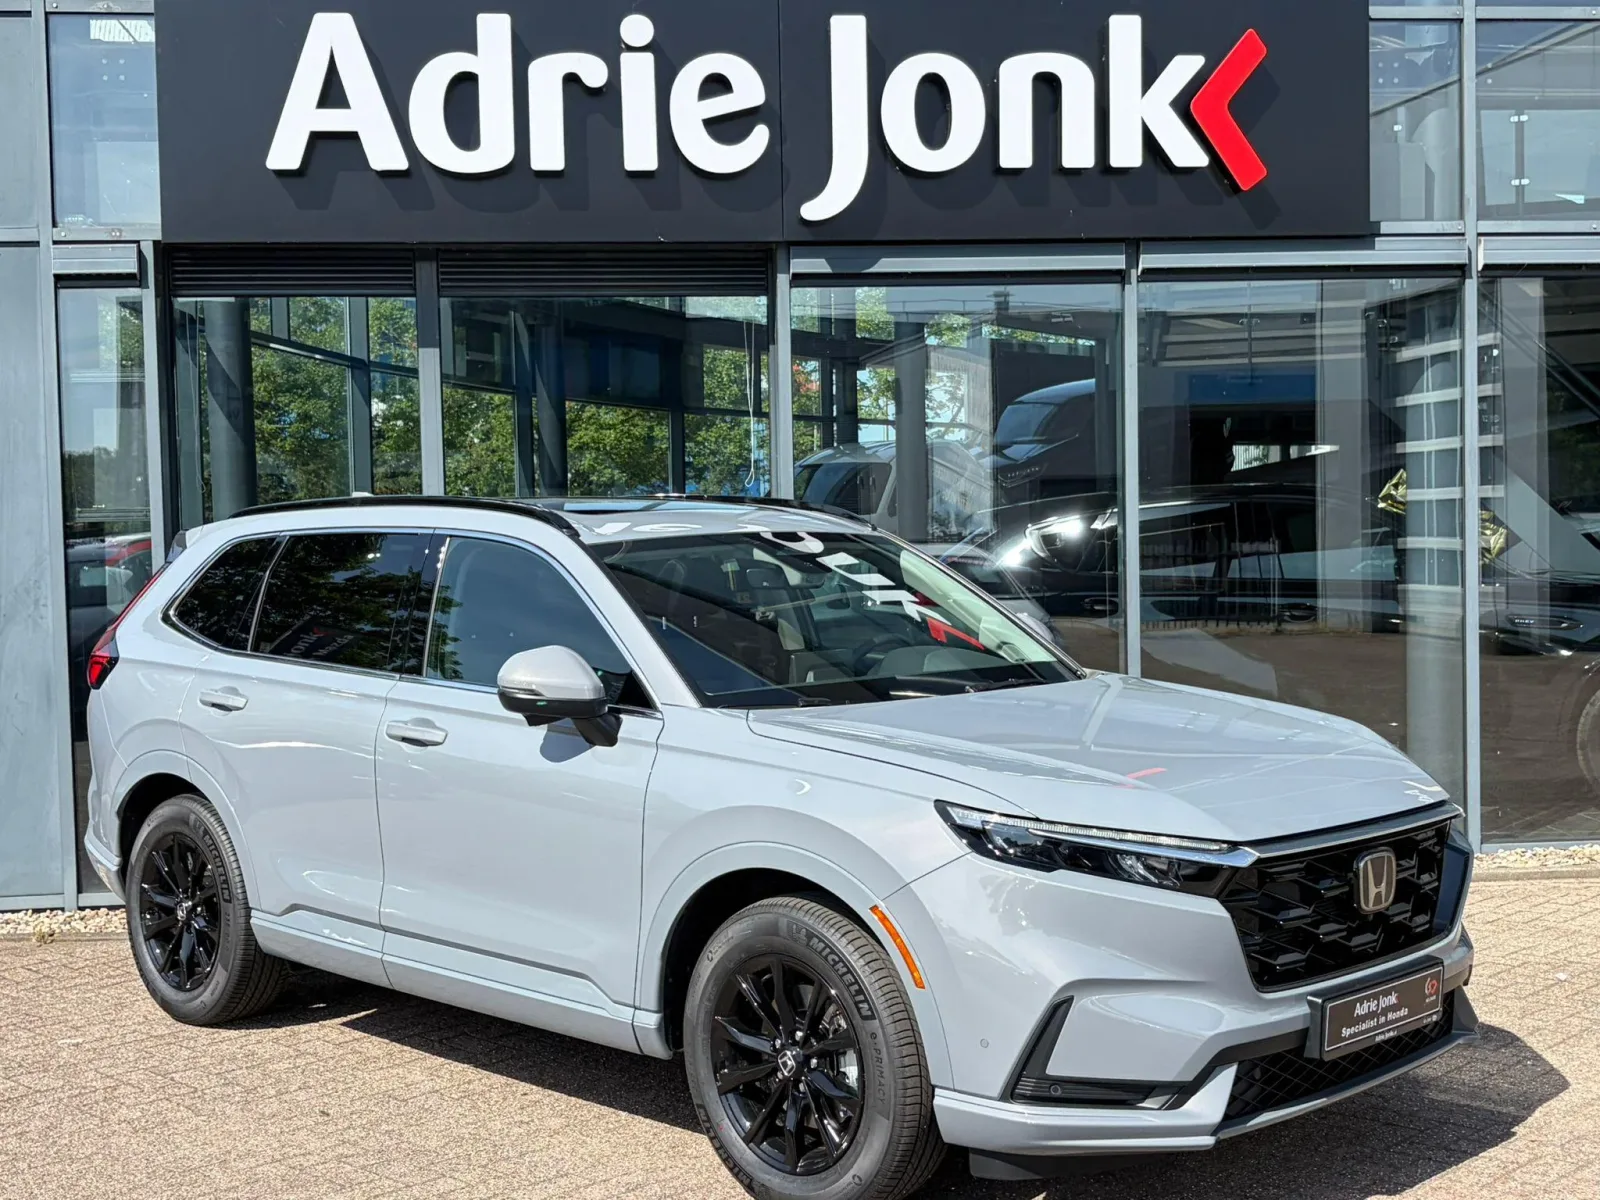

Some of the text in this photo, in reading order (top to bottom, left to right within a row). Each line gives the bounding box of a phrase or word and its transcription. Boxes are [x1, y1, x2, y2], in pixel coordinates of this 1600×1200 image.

[265, 12, 1210, 221] Adrie Jonk
[203, 834, 232, 903] MICHELIN
[808, 937, 873, 1019] MICHELIN
[1354, 991, 1398, 1018] Adrie Jonk
[1341, 1017, 1377, 1038] Specialist
[1378, 1014, 1386, 1025] in
[1387, 1007, 1409, 1021] Honda
